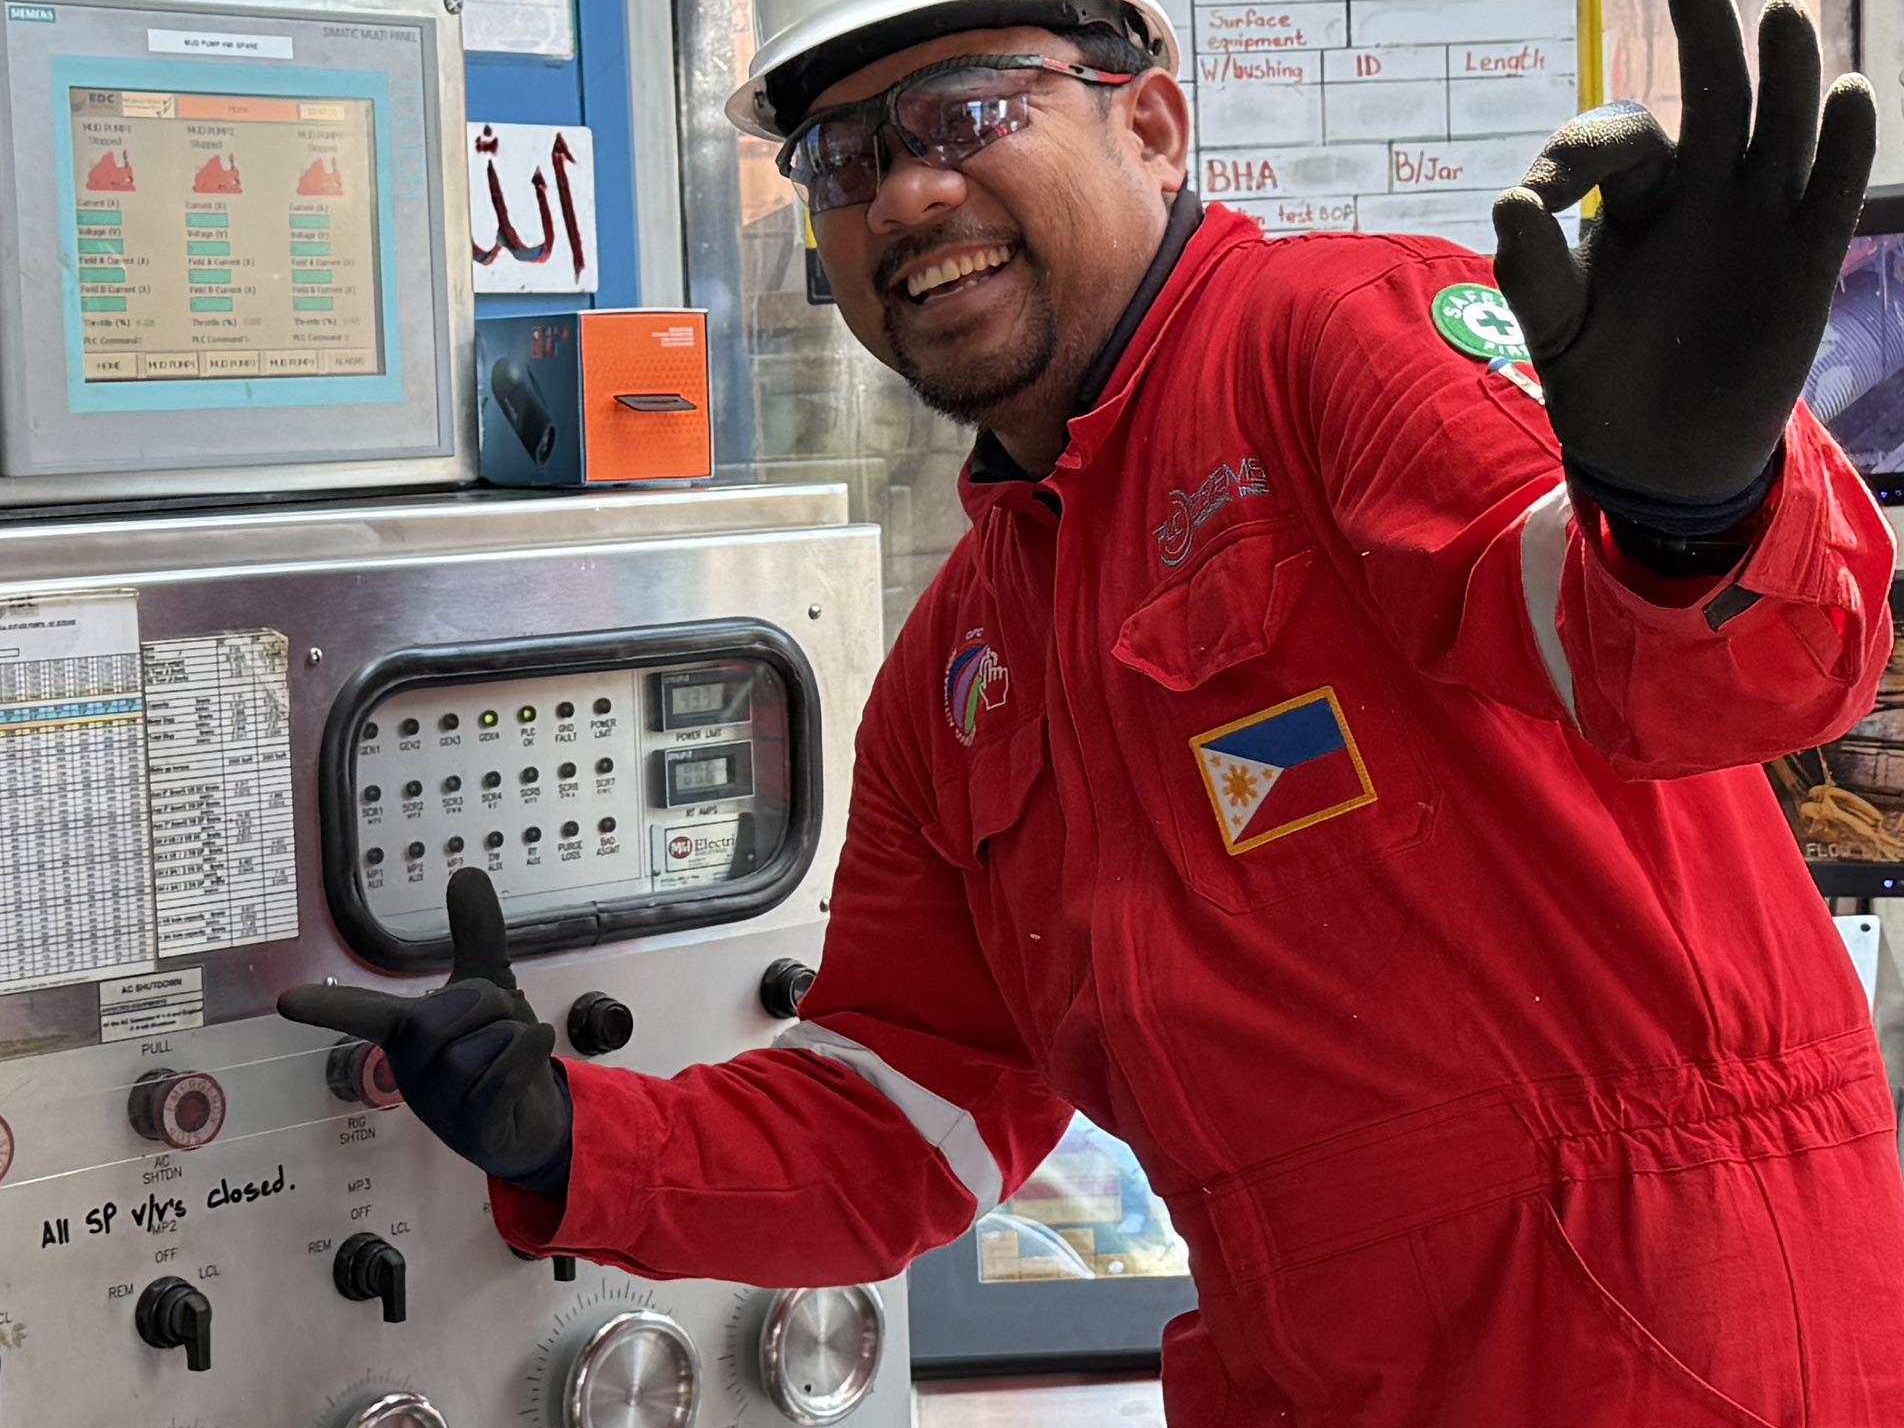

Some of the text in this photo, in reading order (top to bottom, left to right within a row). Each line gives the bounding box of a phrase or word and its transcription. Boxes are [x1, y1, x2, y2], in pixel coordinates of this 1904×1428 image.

[10, 9, 55, 20] SIEMENS
[1209, 4, 1291, 30] Surface
[1208, 29, 1307, 53] equipment
[1201, 47, 1545, 83] W/bushing ID Length
[1207, 158, 1278, 194] BHA
[1279, 201, 1355, 223] test BOP
[142, 1040, 172, 1055] PULL
[340, 1128, 376, 1144] SHTDN
[143, 1167, 182, 1185] SHTDN
[348, 1178, 372, 1193] MP3
[351, 1205, 372, 1219] OFF
[42, 1203, 117, 1248] All SP
[308, 1222, 411, 1253] REM LCL
[155, 1248, 177, 1263] OFF
[109, 1265, 220, 1299] REM LCL
